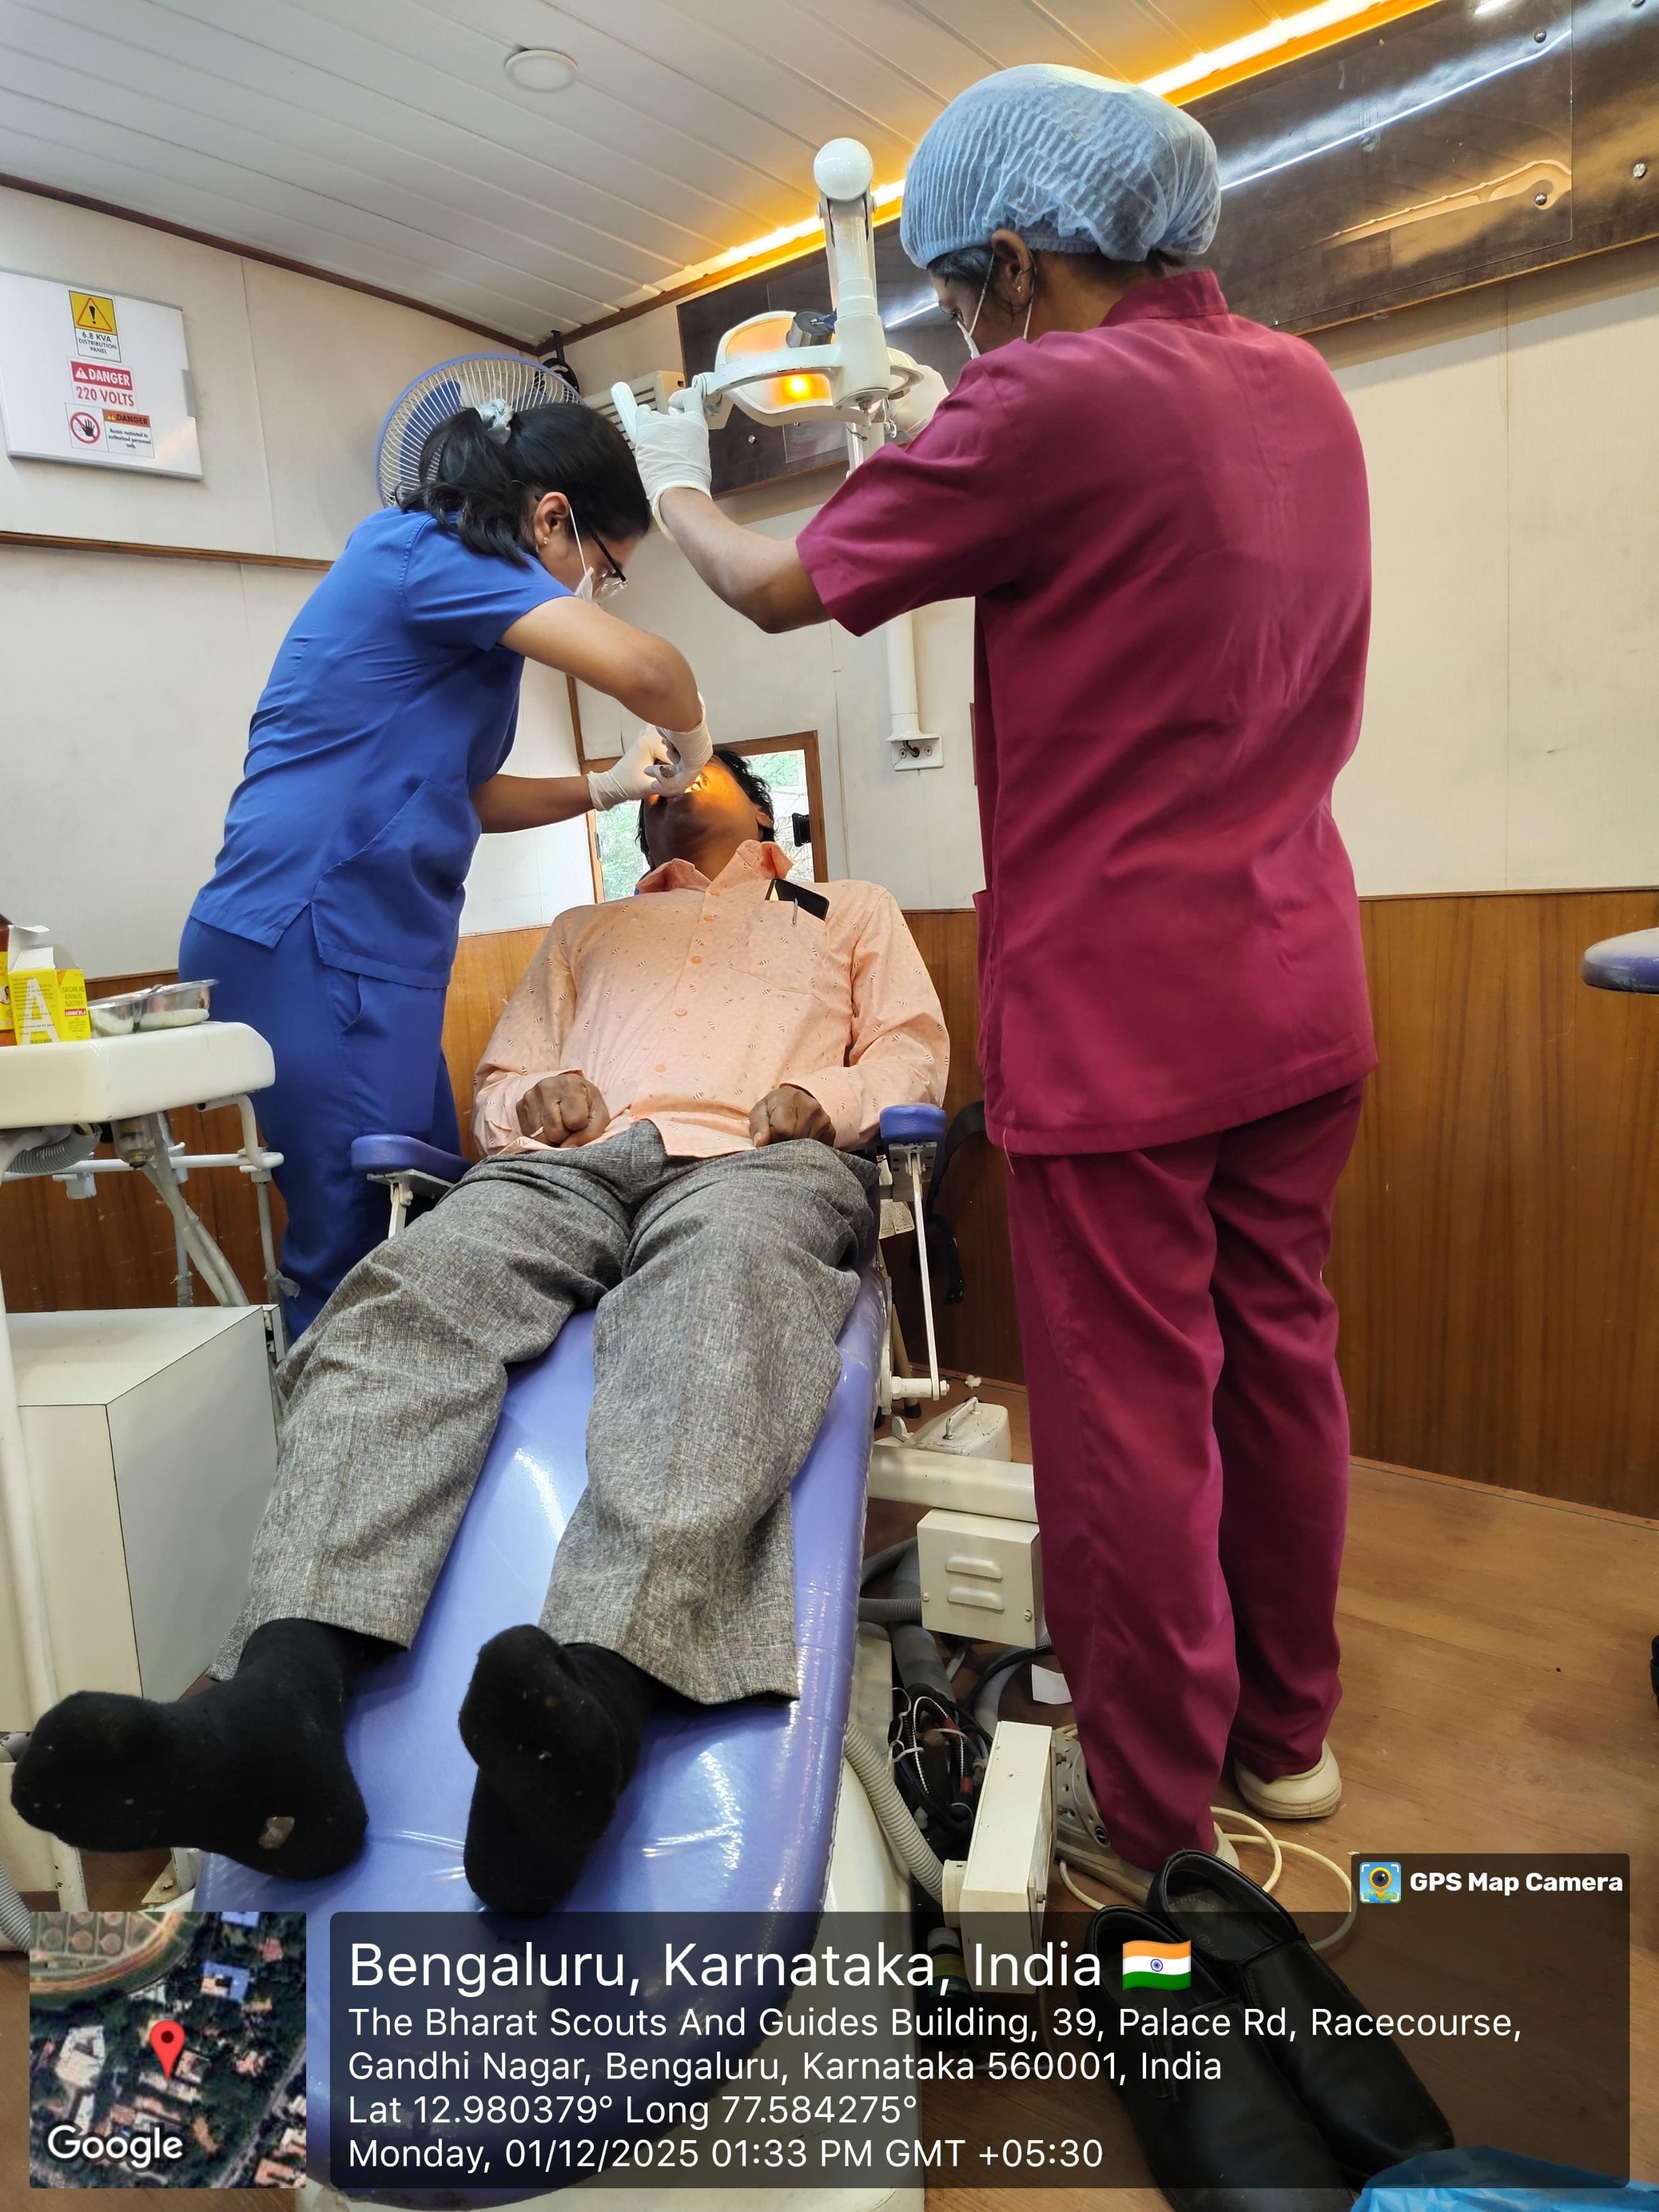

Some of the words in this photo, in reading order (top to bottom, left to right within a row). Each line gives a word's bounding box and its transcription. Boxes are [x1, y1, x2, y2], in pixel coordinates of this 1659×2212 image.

[96, 333, 112, 342] KVA
[78, 339, 117, 350] DISTRIBUTION
[90, 346, 107, 354] PANEL
[88, 368, 131, 386] DANGER
[76, 386, 97, 401] 220
[99, 389, 134, 407] VOLTS
[117, 414, 148, 425] DANGER
